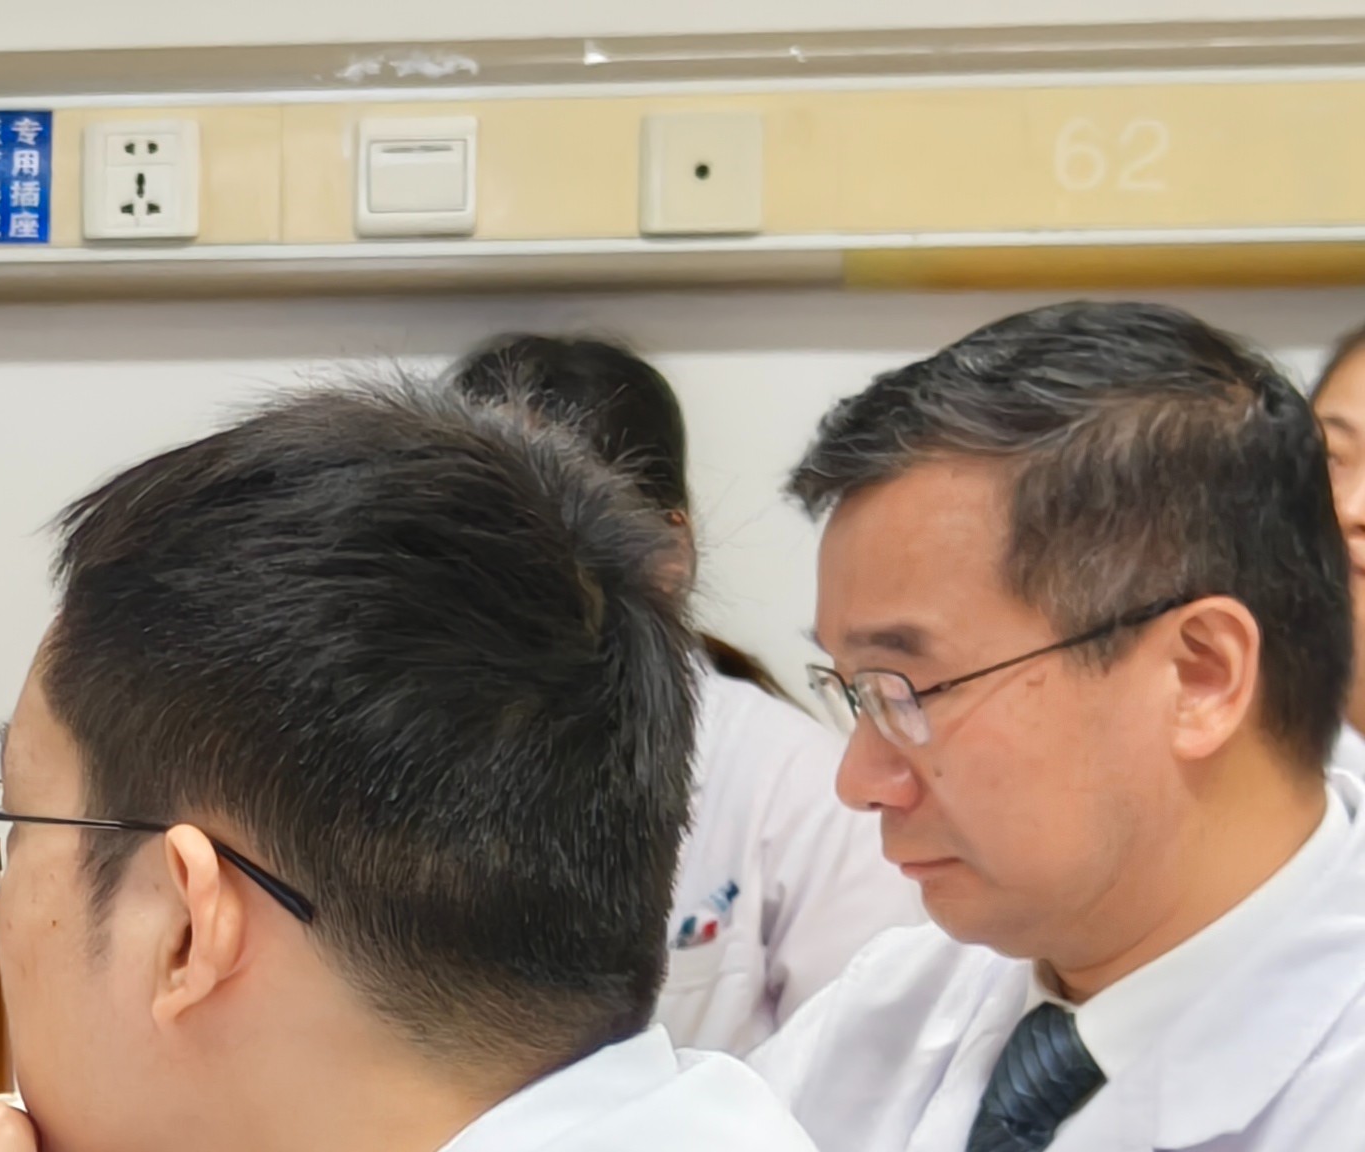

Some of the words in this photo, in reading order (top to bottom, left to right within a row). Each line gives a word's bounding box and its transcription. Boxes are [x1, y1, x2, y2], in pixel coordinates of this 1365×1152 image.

[9, 117, 43, 239] 专用插座
[1054, 116, 1171, 193] 62
